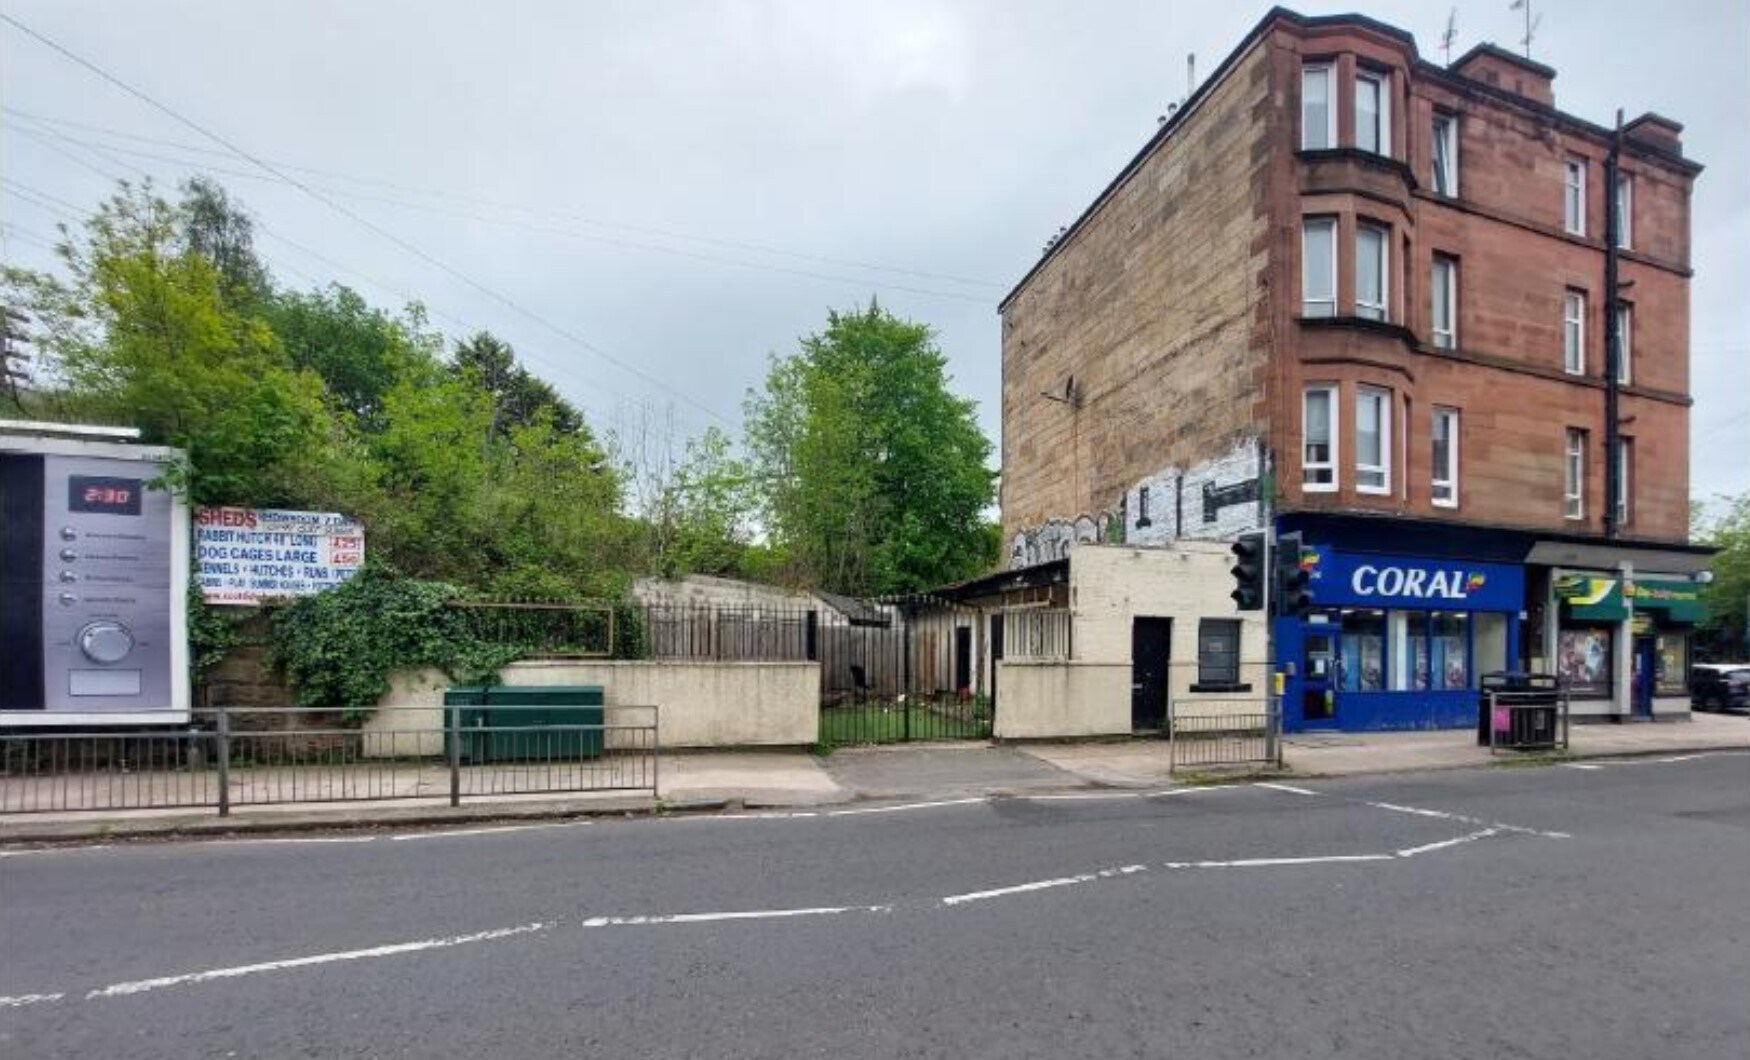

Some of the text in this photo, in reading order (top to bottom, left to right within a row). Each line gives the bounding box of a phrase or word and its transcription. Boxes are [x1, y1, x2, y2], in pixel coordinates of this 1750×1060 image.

[84, 488, 129, 503] 2:30
[200, 509, 257, 528] SHEDS
[197, 545, 317, 563] DOG CAGES LARGE
[203, 562, 239, 574] ENNELS
[1352, 565, 1467, 598] CORAL
